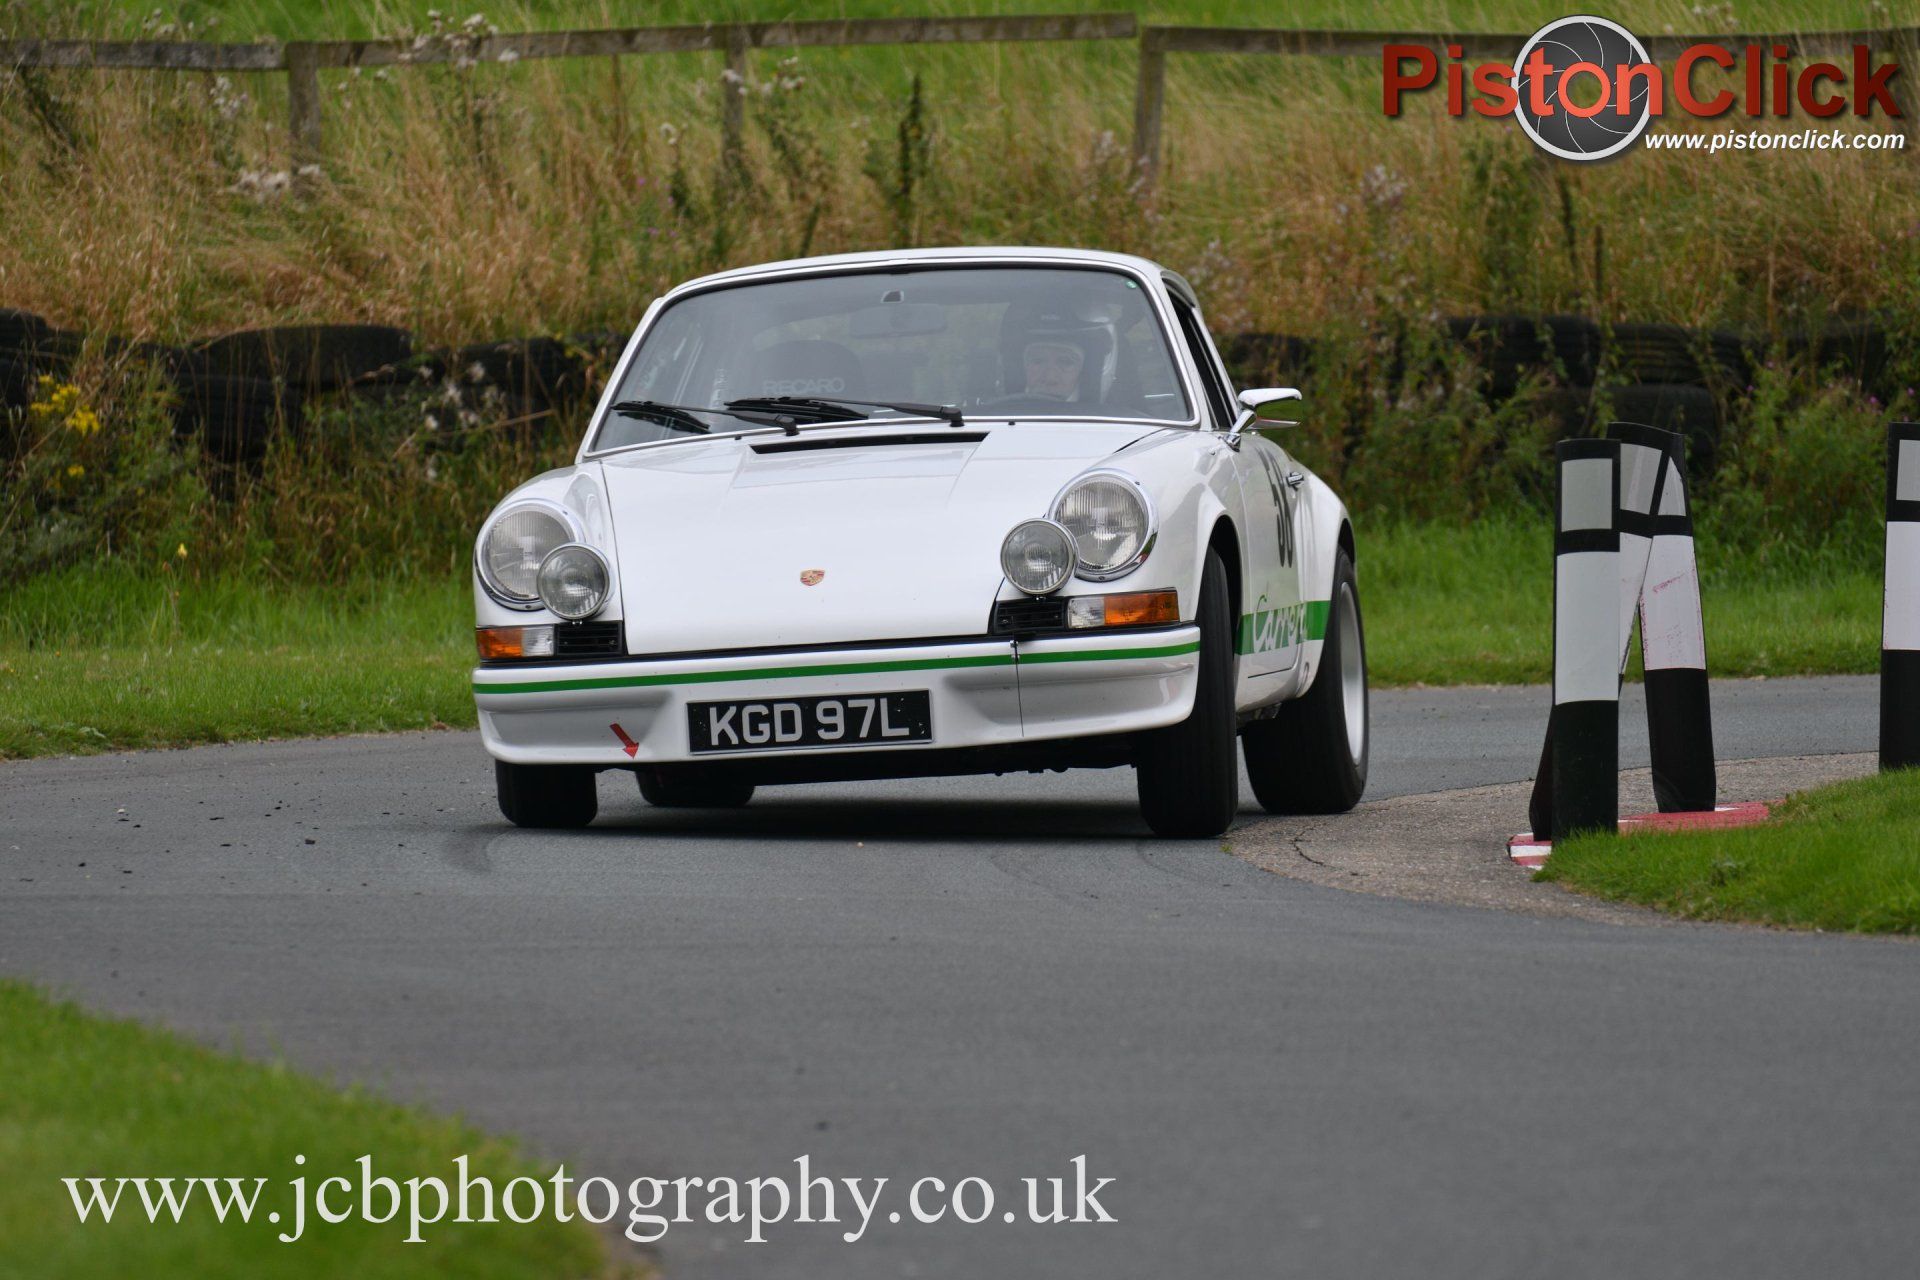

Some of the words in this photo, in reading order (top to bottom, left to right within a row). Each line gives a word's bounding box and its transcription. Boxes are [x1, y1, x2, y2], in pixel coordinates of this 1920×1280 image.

[763, 377, 846, 396] RECARO
[709, 703, 803, 746] KGD
[815, 697, 910, 740] 97L
